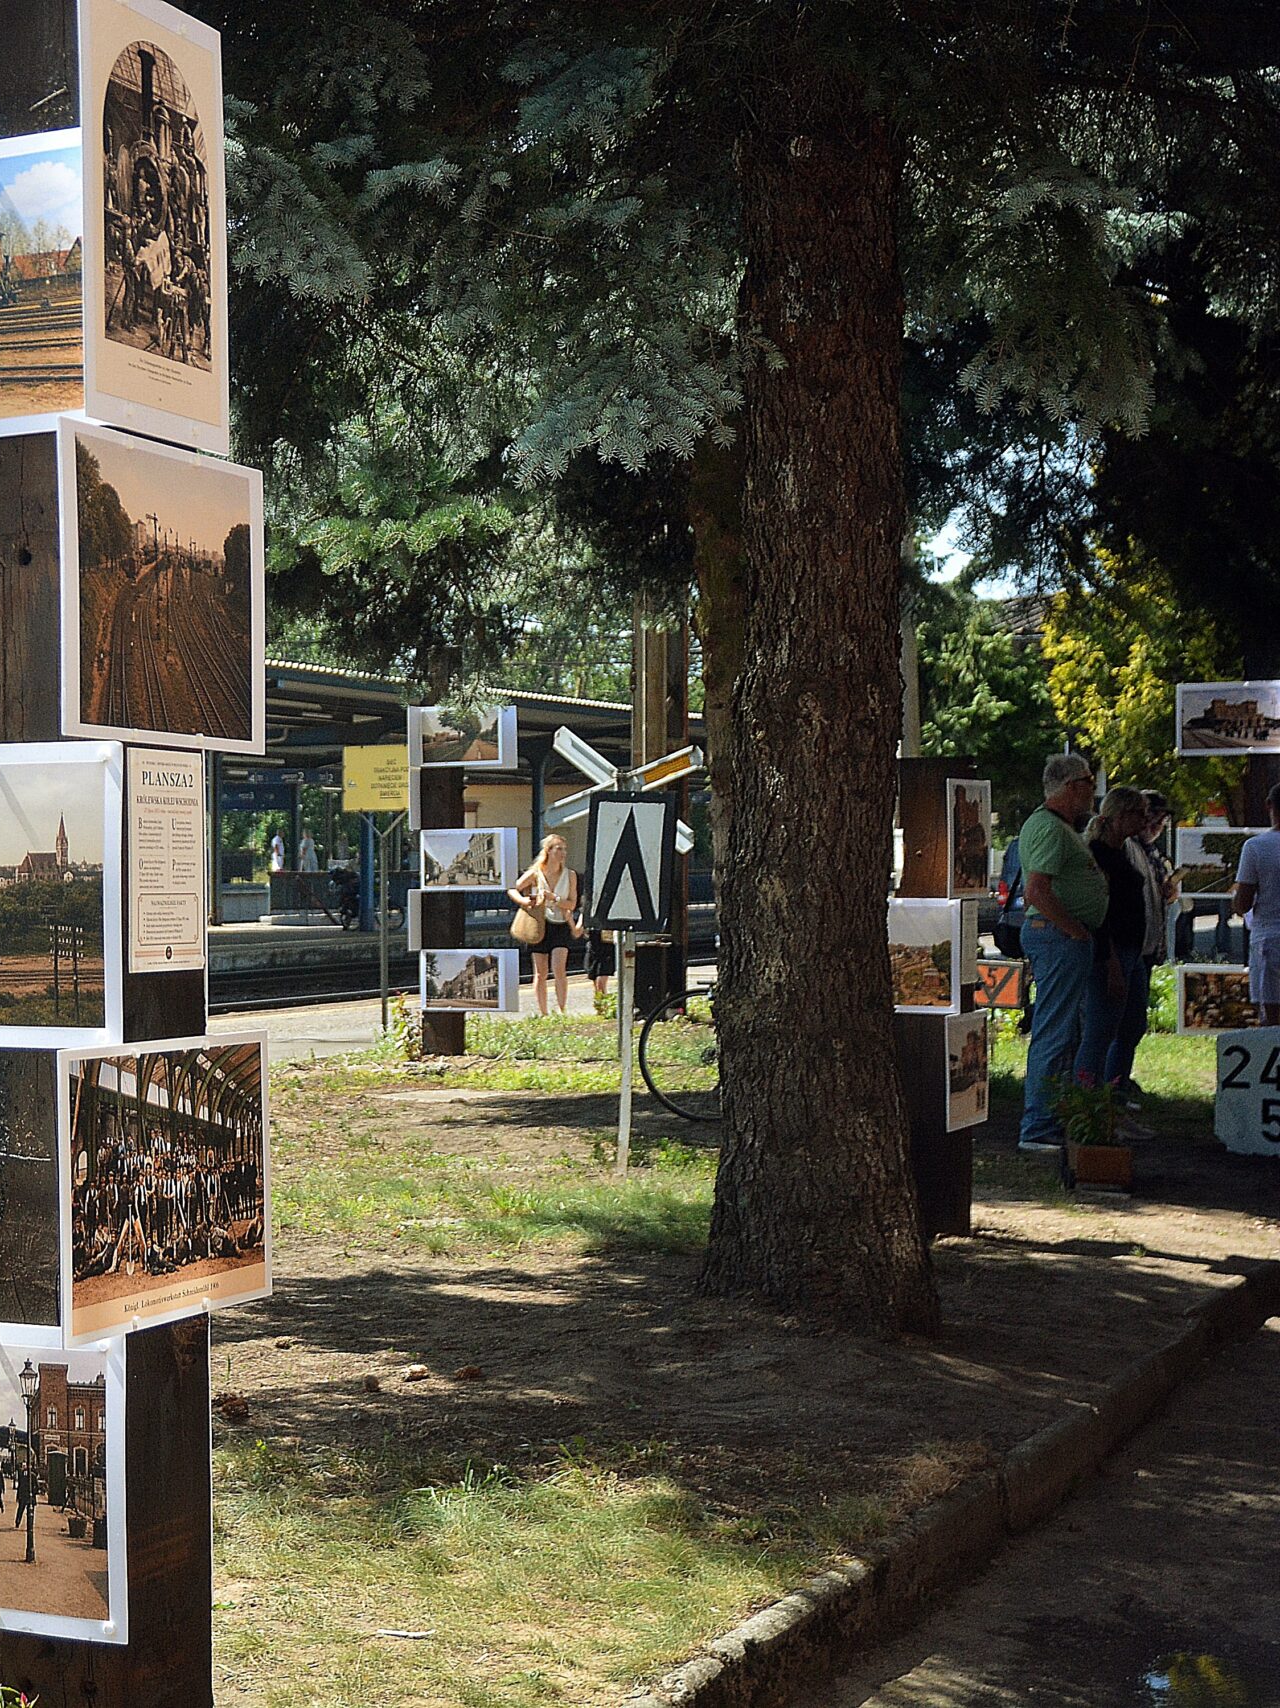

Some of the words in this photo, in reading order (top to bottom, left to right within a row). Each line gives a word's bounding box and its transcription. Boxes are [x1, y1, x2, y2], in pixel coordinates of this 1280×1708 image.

[142, 770, 188, 788] PLANSZA
[188, 774, 194, 788] 2
[984, 967, 997, 988] 5
